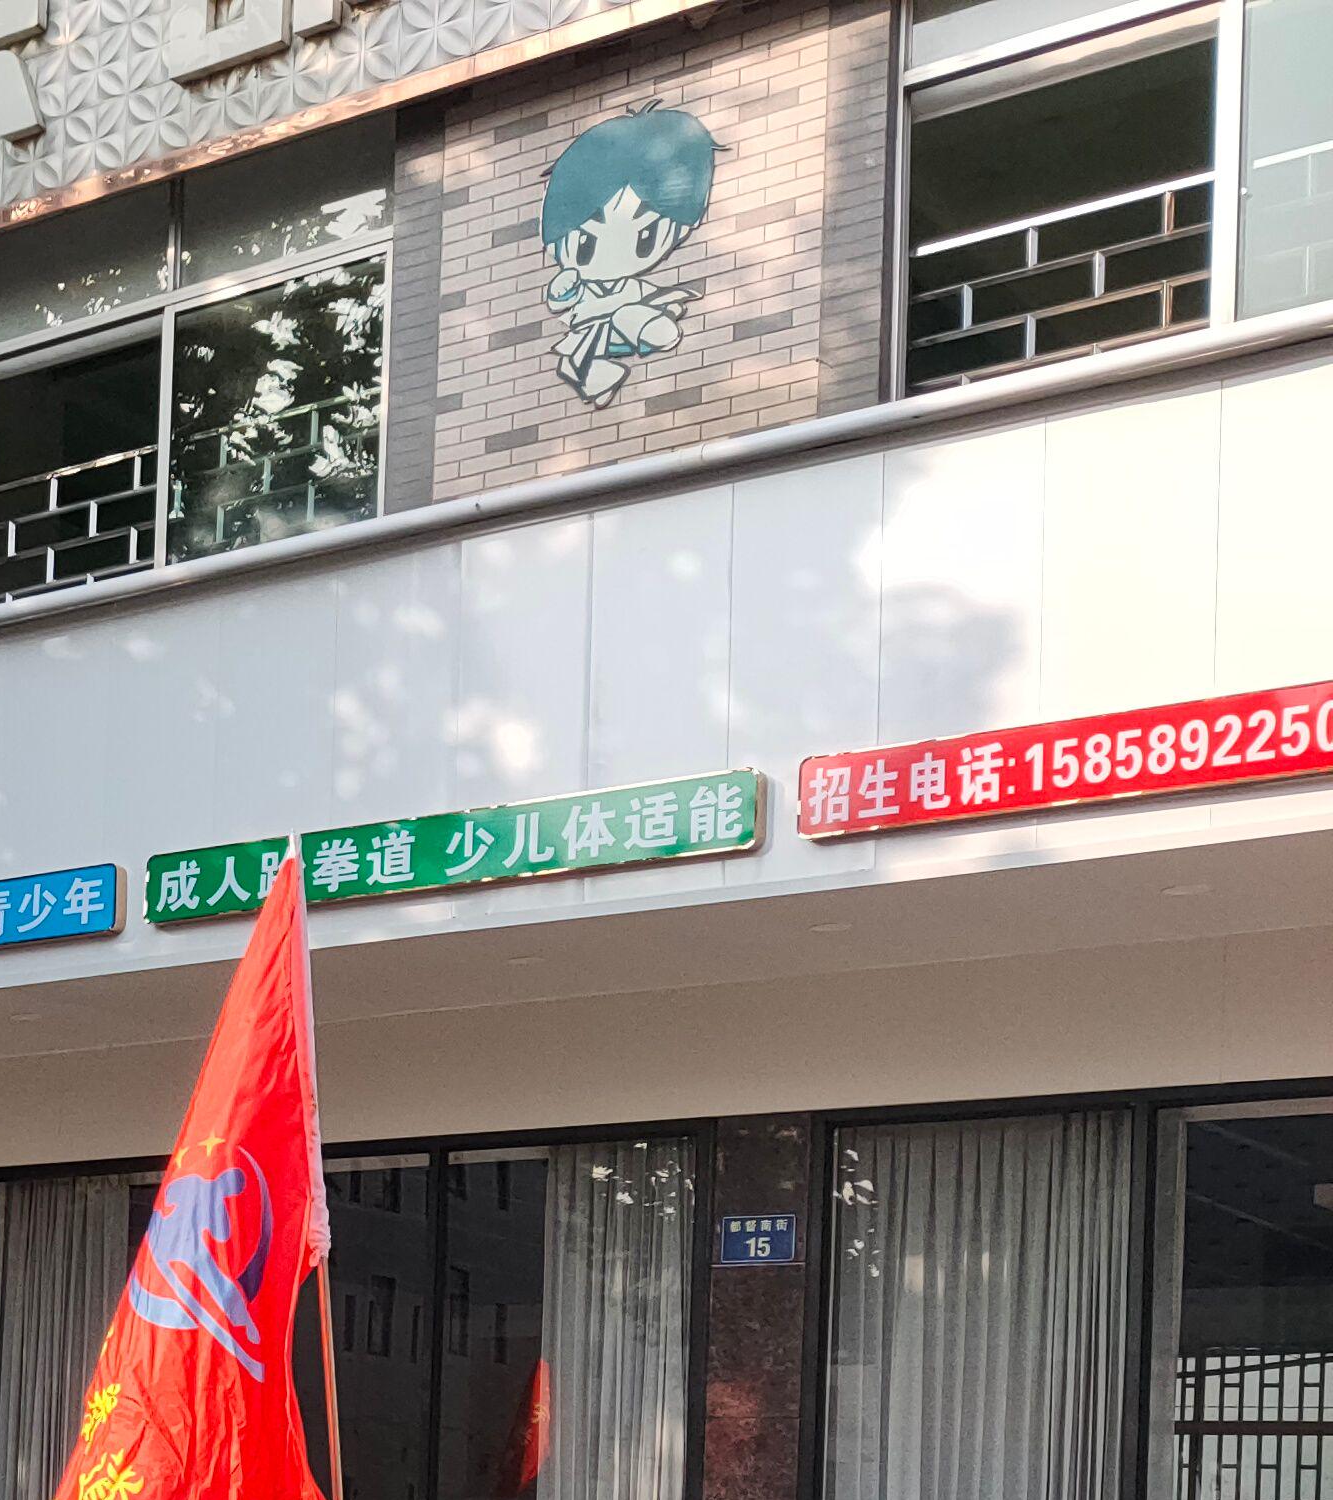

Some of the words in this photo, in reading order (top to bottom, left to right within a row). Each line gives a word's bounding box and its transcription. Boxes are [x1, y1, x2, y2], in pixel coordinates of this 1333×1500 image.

[443, 782, 745, 876] 少儿体适能
[743, 1236, 772, 1258] 15
